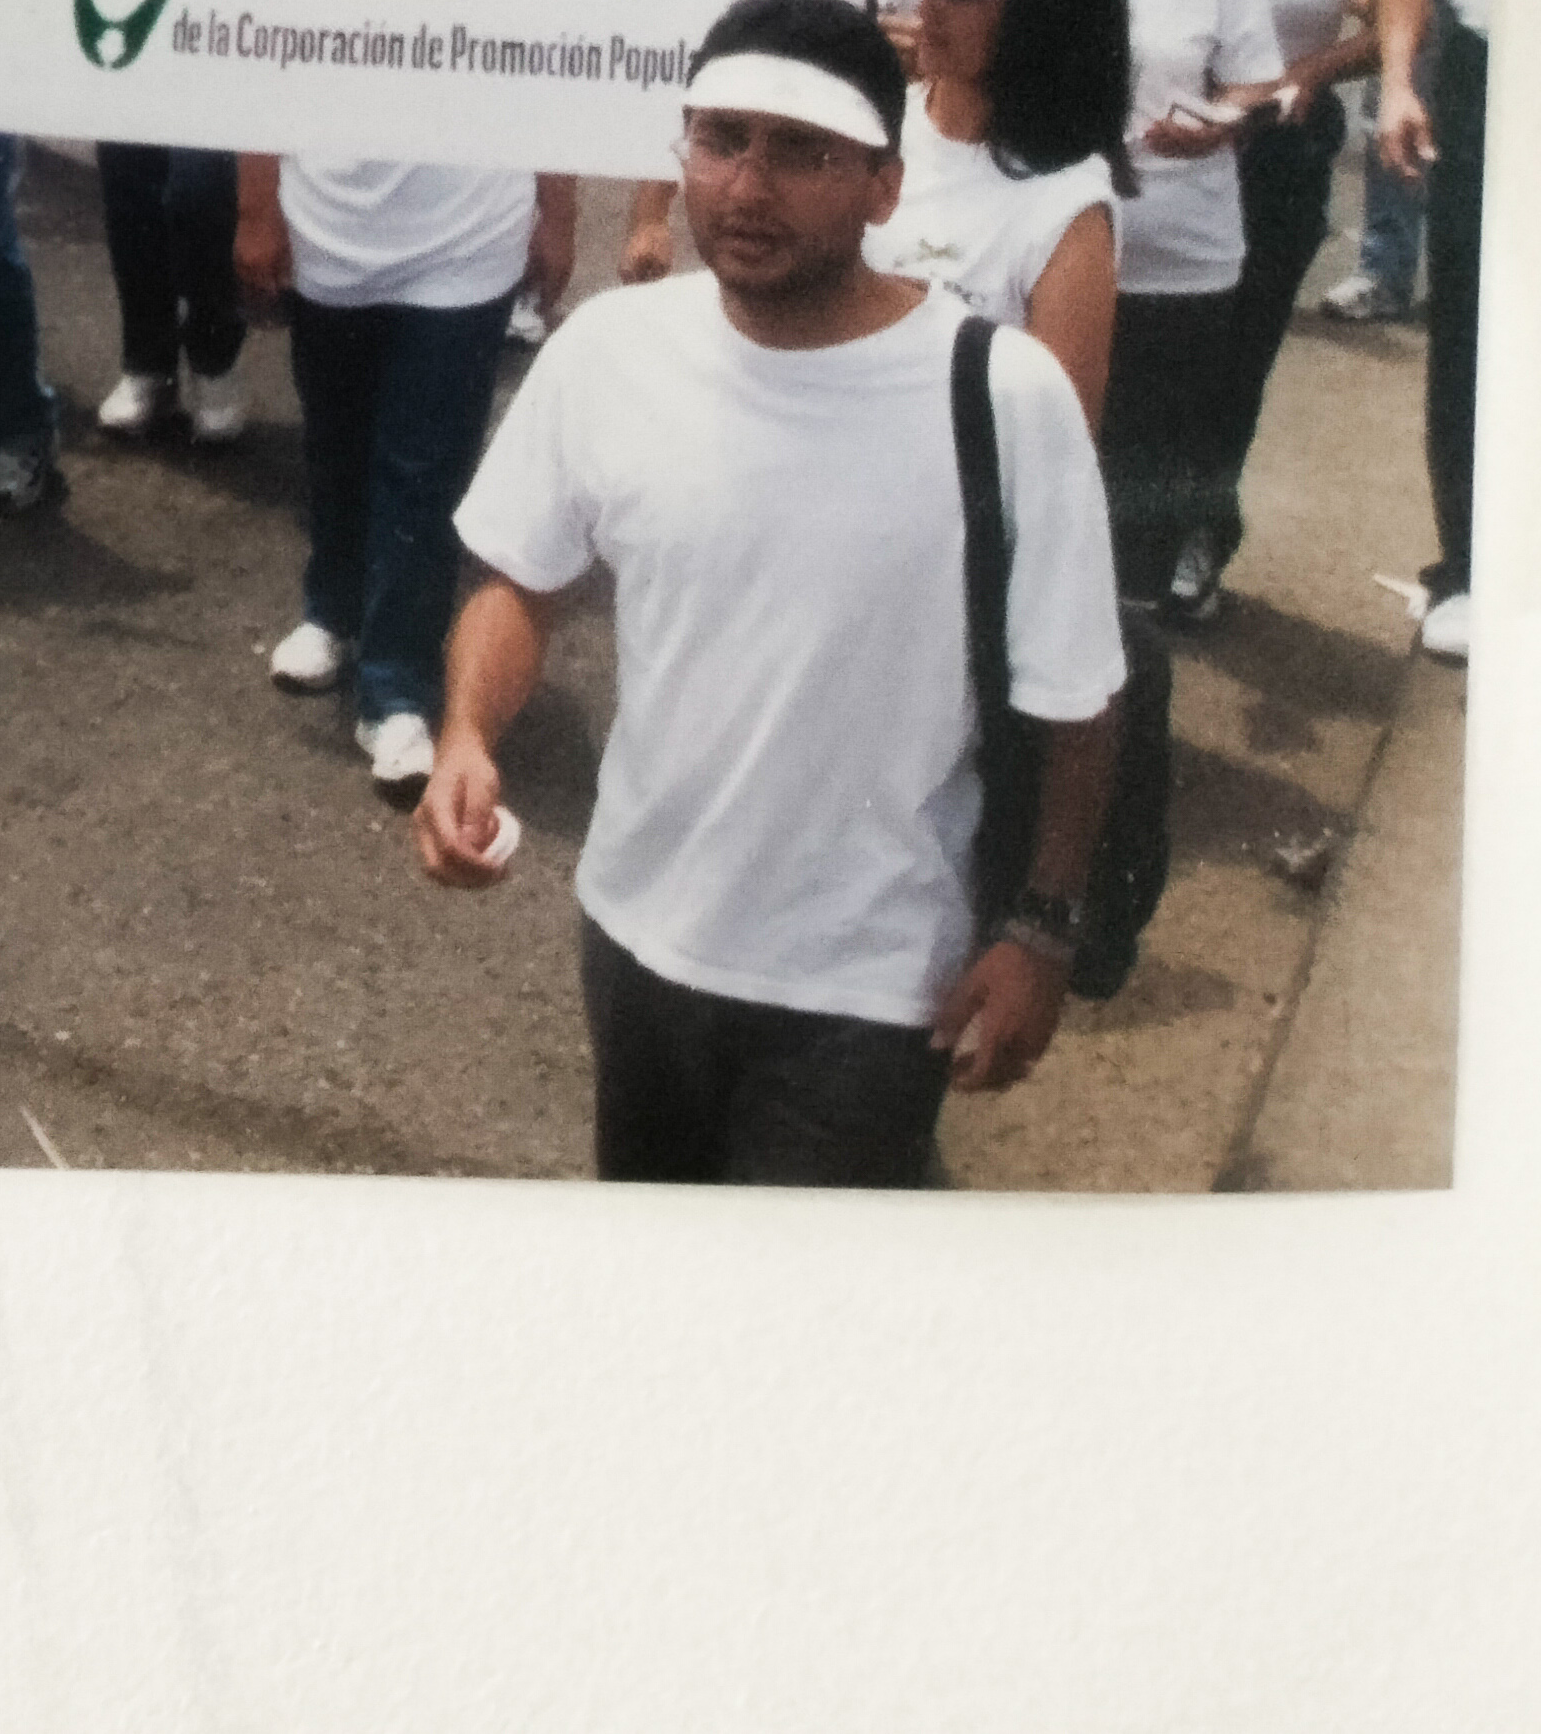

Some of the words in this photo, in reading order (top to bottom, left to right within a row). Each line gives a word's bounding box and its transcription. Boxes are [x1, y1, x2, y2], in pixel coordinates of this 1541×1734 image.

[173, 8, 202, 54] de
[207, 9, 230, 57] la
[236, 12, 404, 69] Corporación
[412, 22, 443, 70] de
[449, 24, 601, 81] Promoción
